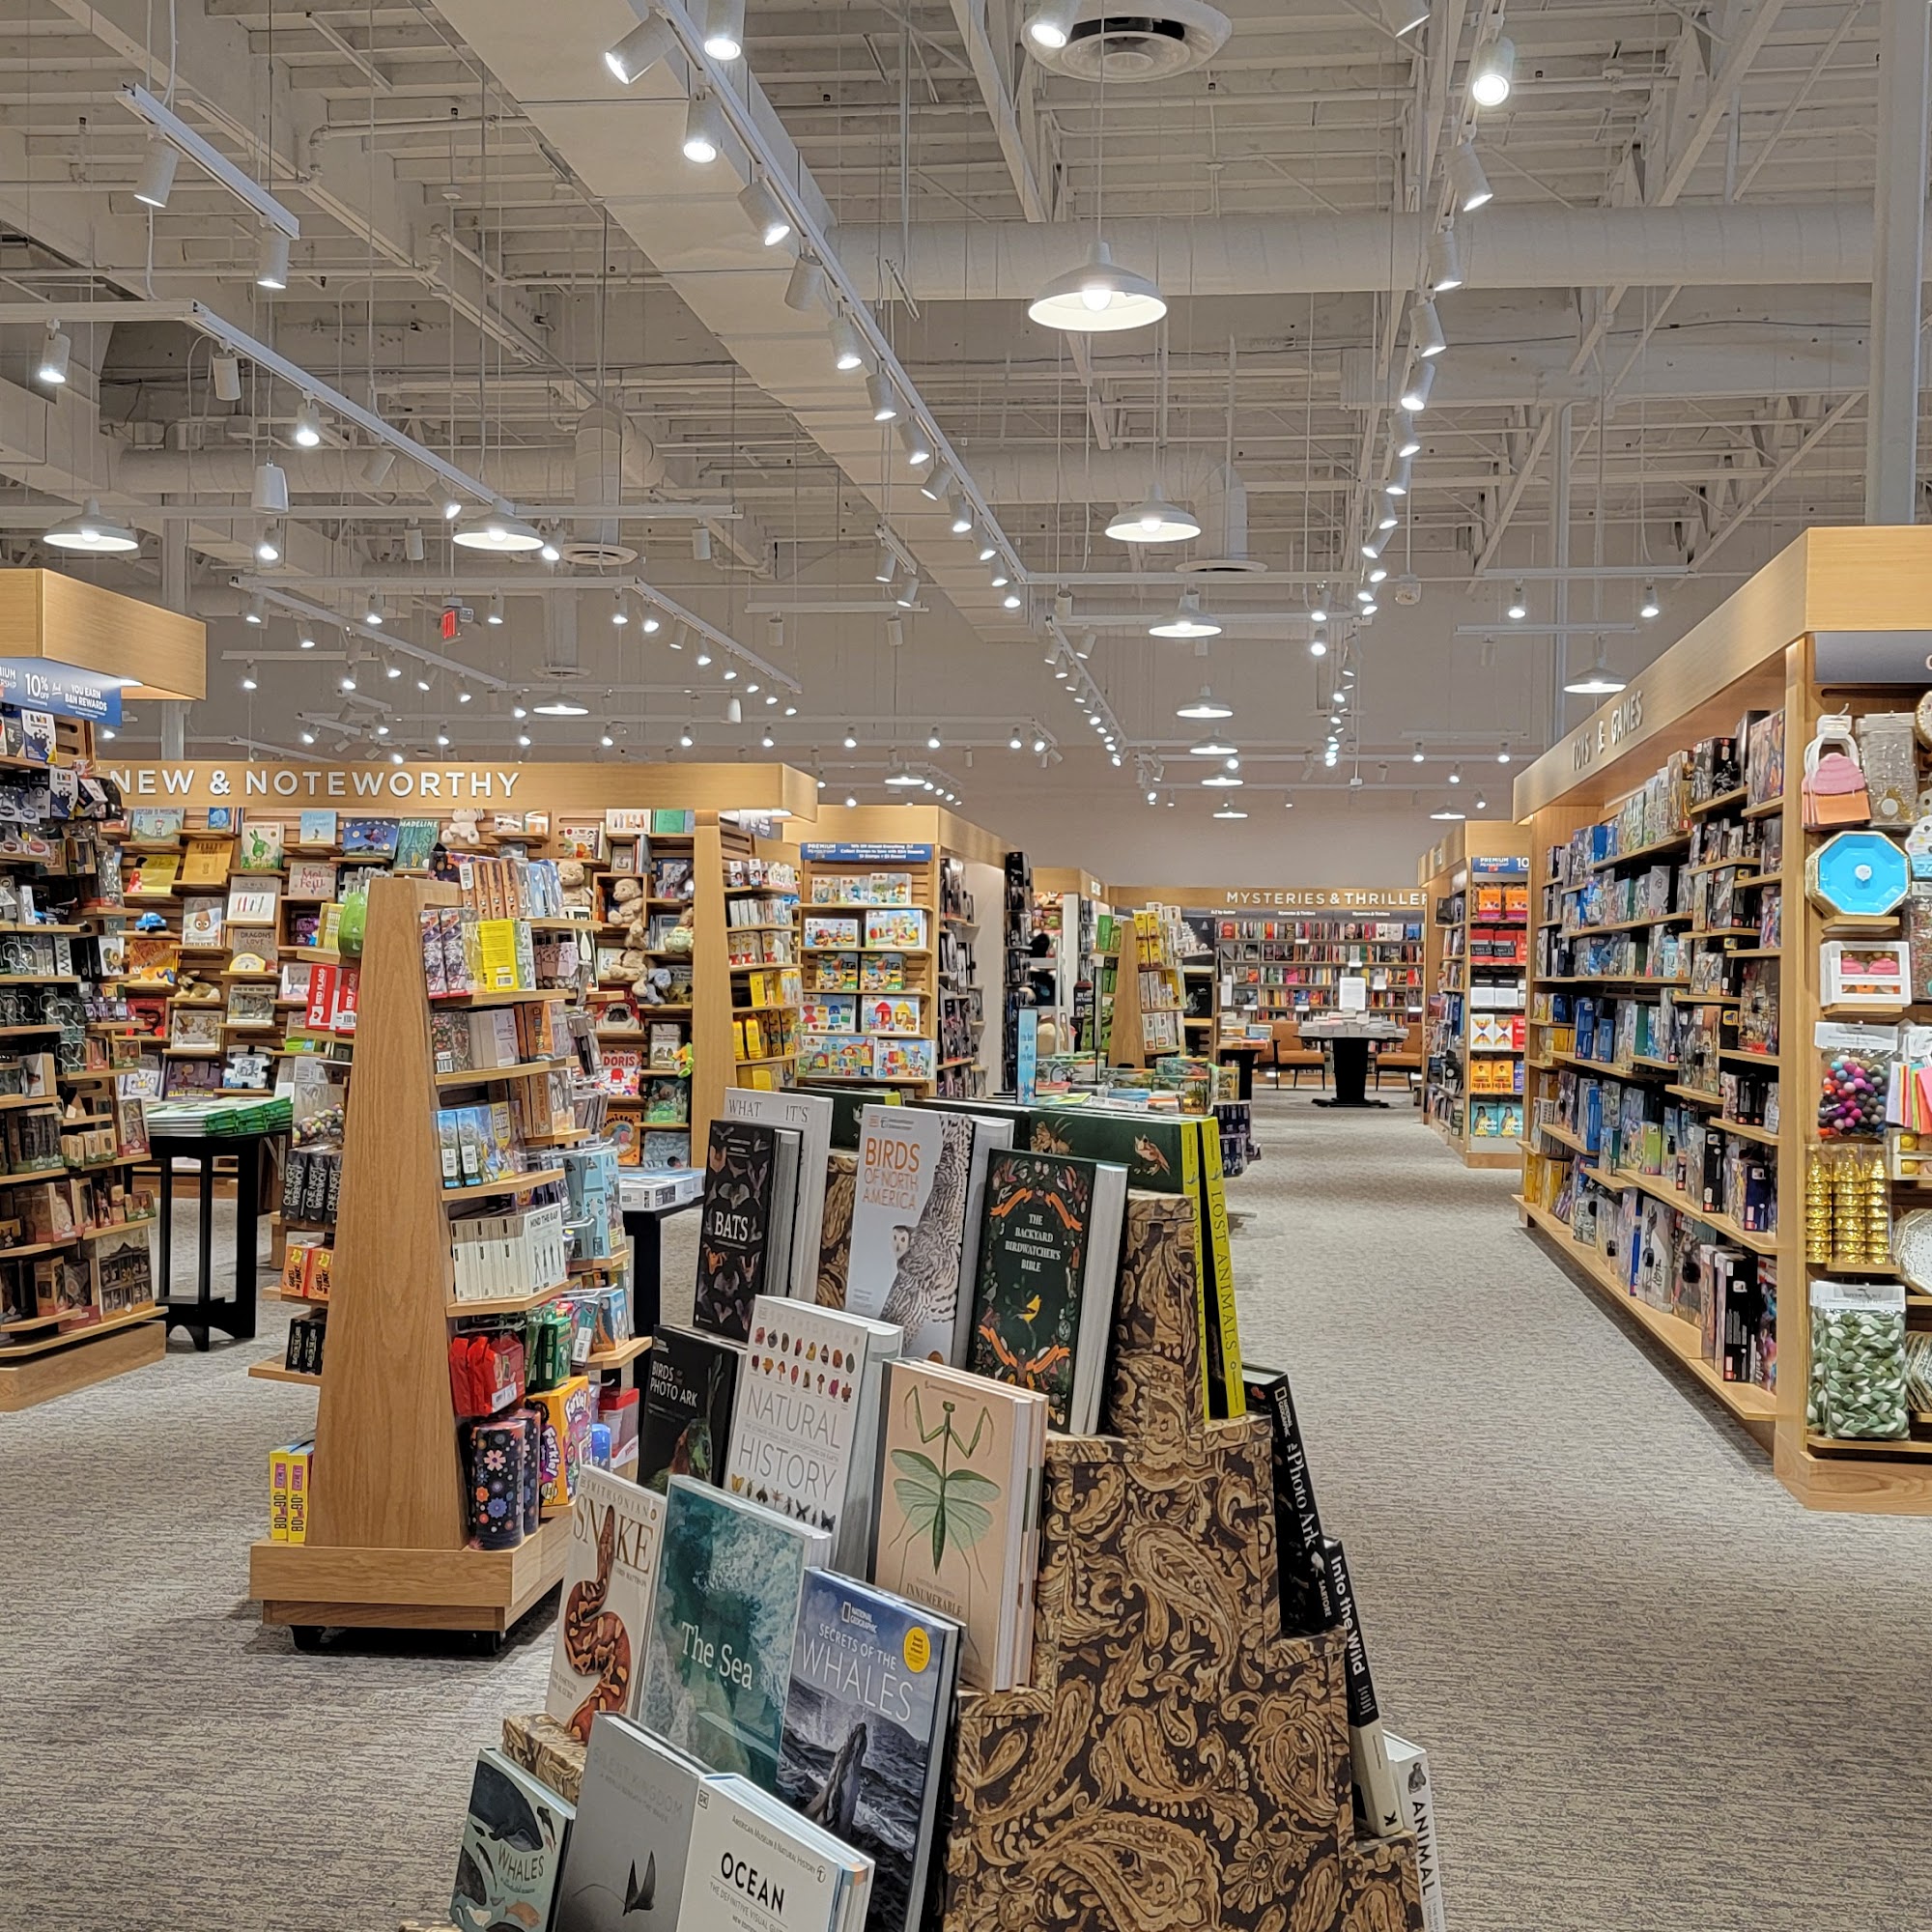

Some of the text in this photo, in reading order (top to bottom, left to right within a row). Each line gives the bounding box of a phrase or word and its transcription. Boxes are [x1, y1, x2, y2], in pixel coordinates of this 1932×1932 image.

[25, 673, 48, 697] 10%
[71, 684, 101, 699] YOU EARN
[65, 694, 107, 711] B&N REWARDS
[1573, 690, 1642, 771] TOYS & GAMES
[110, 769, 520, 797] NEW & NOTEWORTHY
[1227, 893, 1325, 904] MYSTERIES
[1329, 893, 1341, 905] &
[315, 968, 327, 1005] RED FLAGS
[346, 995, 355, 1009] RED
[603, 1056, 636, 1066] DORIS
[728, 1099, 810, 1122] WHAT IT'S
[866, 1138, 920, 1173] BIRDS
[290, 1165, 303, 1207] WEREWOLF
[313, 1168, 327, 1209] WEREWOLF
[865, 1168, 919, 1191] OF NORTH
[283, 1188, 294, 1206] ONE
[306, 1190, 317, 1208] ONE
[327, 1193, 338, 1211] ONE
[862, 1188, 916, 1210] AMERICA
[715, 1211, 749, 1242] BATS
[1029, 1213, 1043, 1226] THE
[1211, 1190, 1227, 1242] LOST
[1005, 1240, 1061, 1260] BIRDWATCHER'S
[1014, 1227, 1054, 1242] BACKYARD
[1021, 1259, 1041, 1272] BIBLE
[1217, 1253, 1237, 1350] ANIMALS
[652, 1360, 674, 1381] BIRDS
[650, 1378, 697, 1407] PHOTO ARK
[747, 1383, 840, 1449] NATURAL
[542, 1426, 560, 1477] Farkle!
[739, 1434, 837, 1501] HISTORY
[586, 1478, 648, 1517] SMITHSONIAN
[1287, 1449, 1308, 1509] Photo
[1299, 1513, 1320, 1549] Ark
[906, 1583, 962, 1617] INNUMERABLE
[1319, 1579, 1332, 1617] SARTORE
[1331, 1555, 1347, 1595] Into
[1340, 1597, 1353, 1631] the
[850, 1615, 878, 1634] GEOGRAPHIC
[851, 1606, 872, 1622] NATIONAL
[681, 1621, 753, 1690] The Sea
[819, 1623, 858, 1652] SECRETS
[860, 1643, 874, 1659] OF
[877, 1650, 896, 1670] THE
[803, 1633, 914, 1721] WHALES
[498, 1843, 544, 1883] WHALES
[1412, 1802, 1435, 1895] ANIMAL
[721, 1852, 784, 1917] OCEAN
[710, 1882, 720, 1895] THE
[721, 1889, 749, 1916] DEFINITIVE
[750, 1910, 768, 1929] VISUAL
